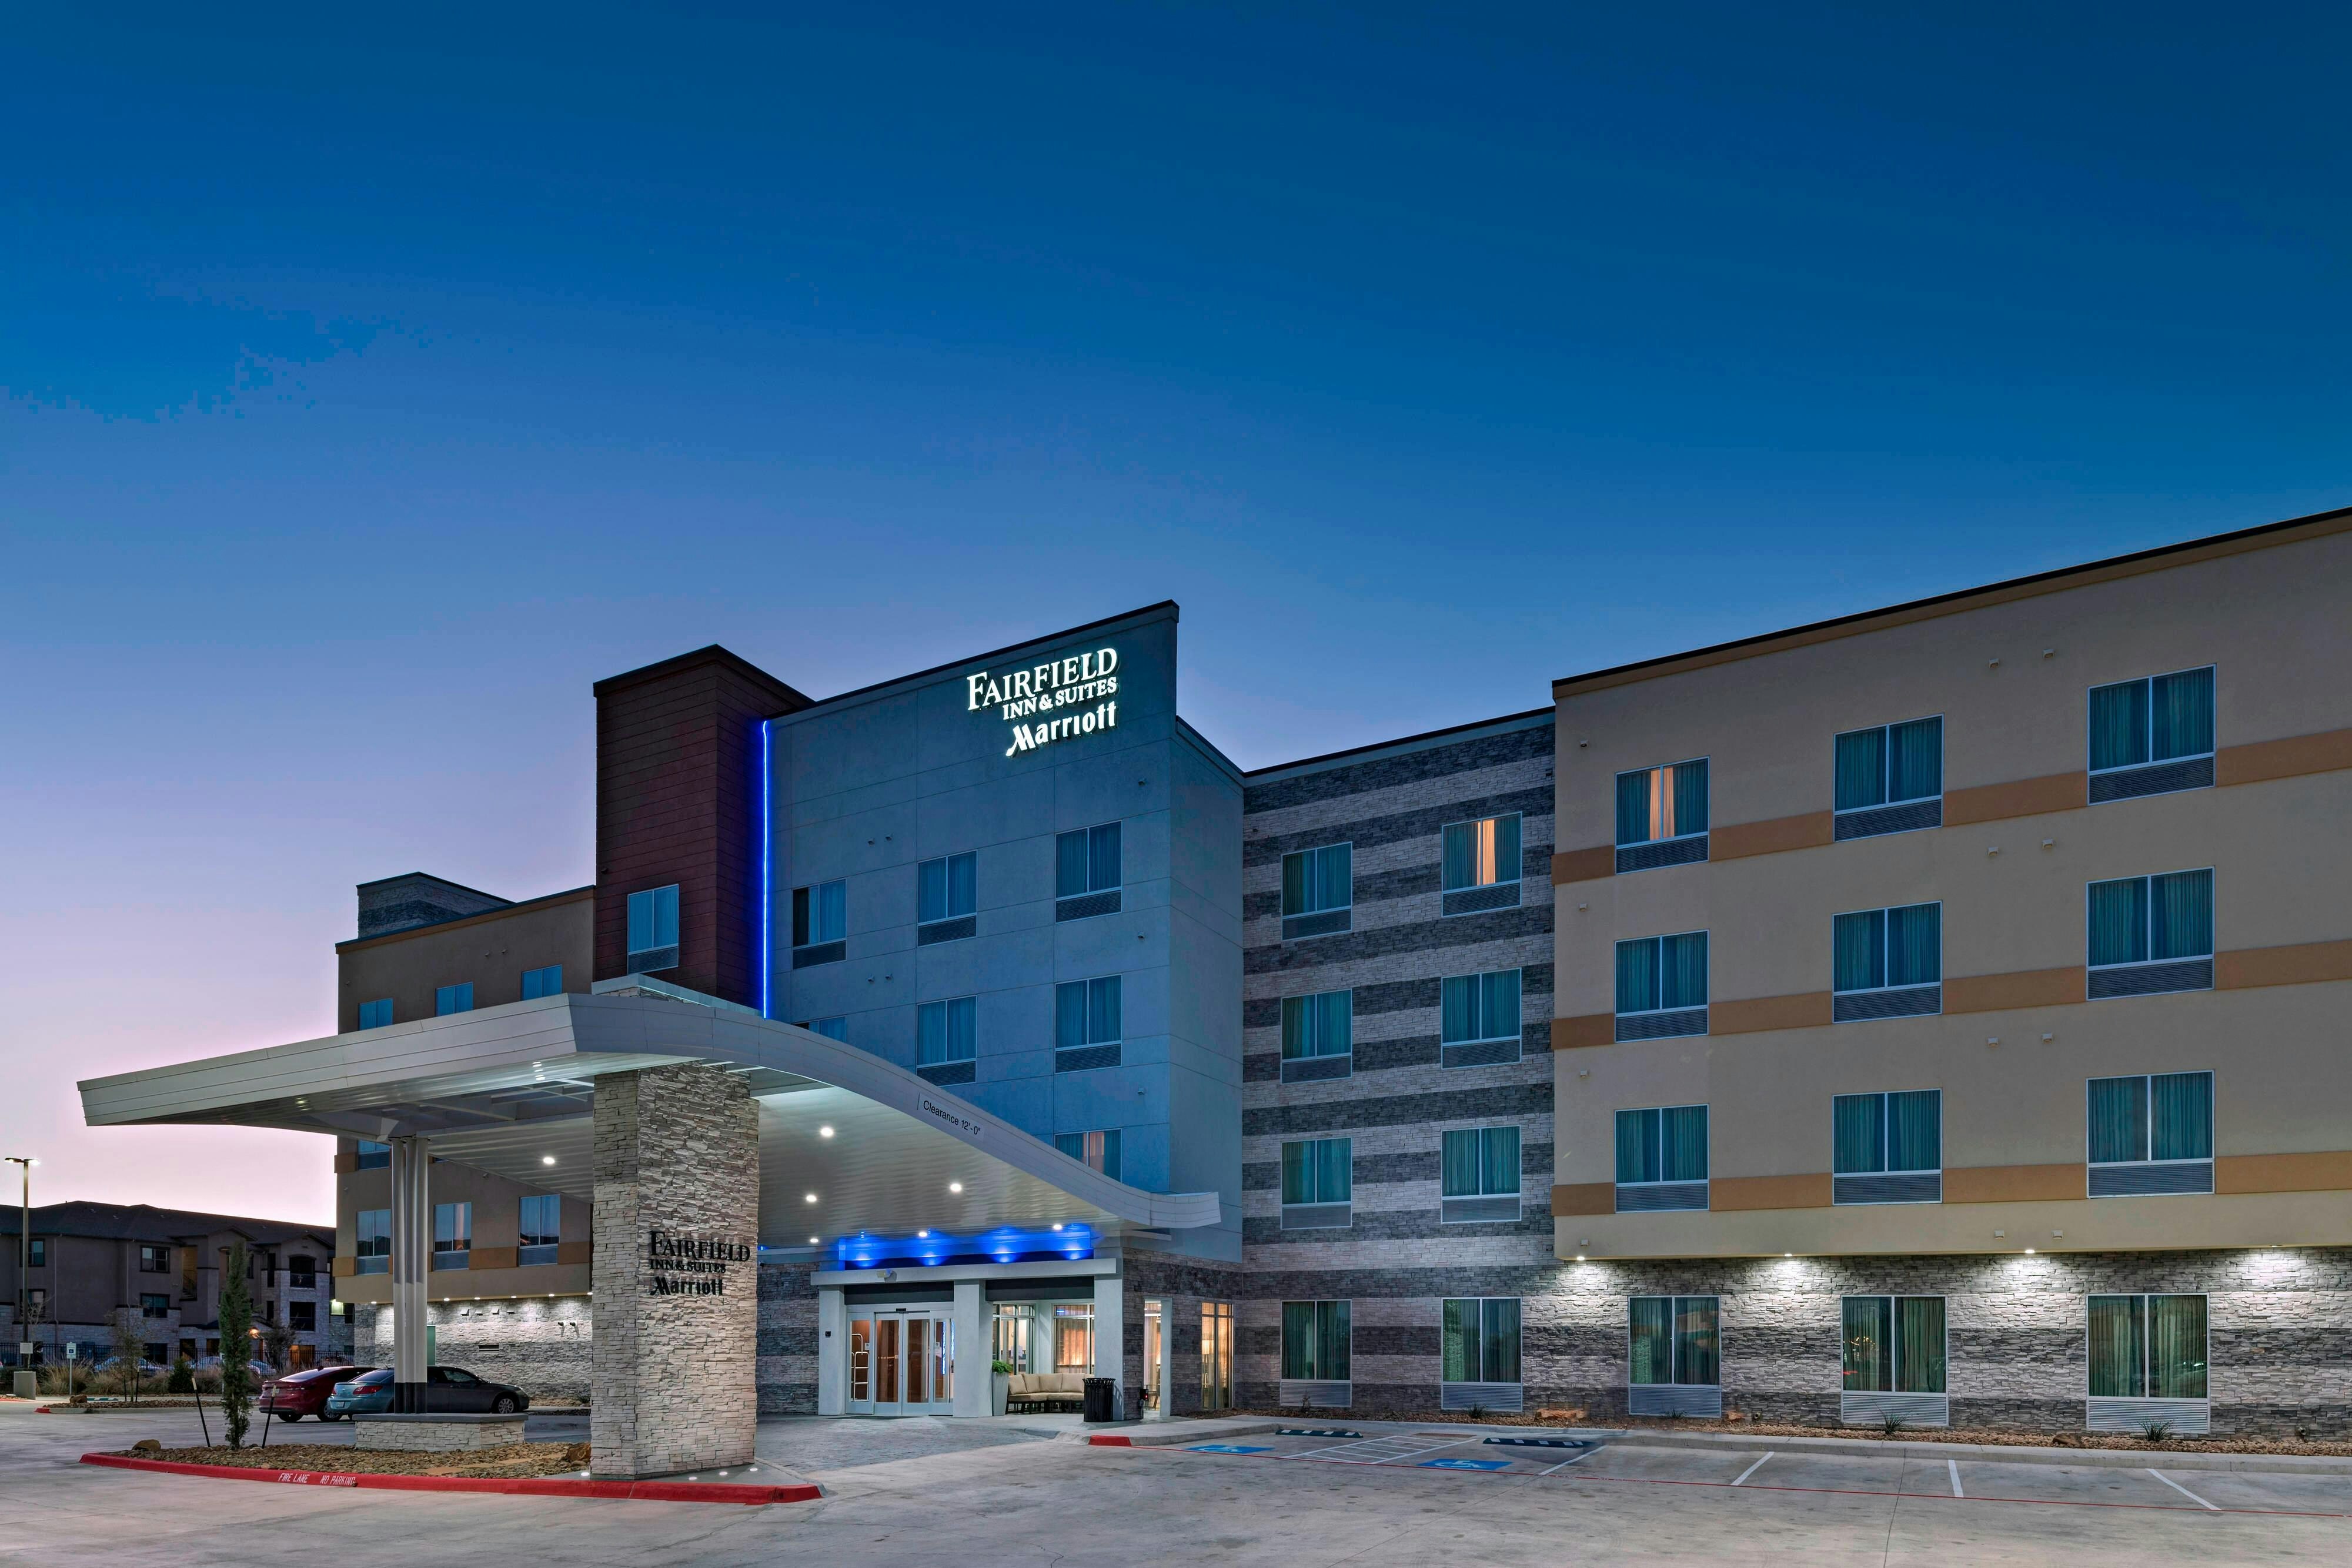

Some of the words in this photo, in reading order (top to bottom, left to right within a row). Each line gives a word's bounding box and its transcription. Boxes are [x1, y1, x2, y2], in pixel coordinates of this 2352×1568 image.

[967, 648, 1118, 711] FAIRFIELD
[1006, 701, 1117, 757] Marriott
[923, 1100, 959, 1125] Clearance
[650, 1231, 750, 1262] FAIRFIELD
[650, 1276, 723, 1295] Marriott
[278, 1473, 293, 1482] FIRE
[293, 1473, 310, 1483] LANE
[320, 1475, 330, 1485] NO
